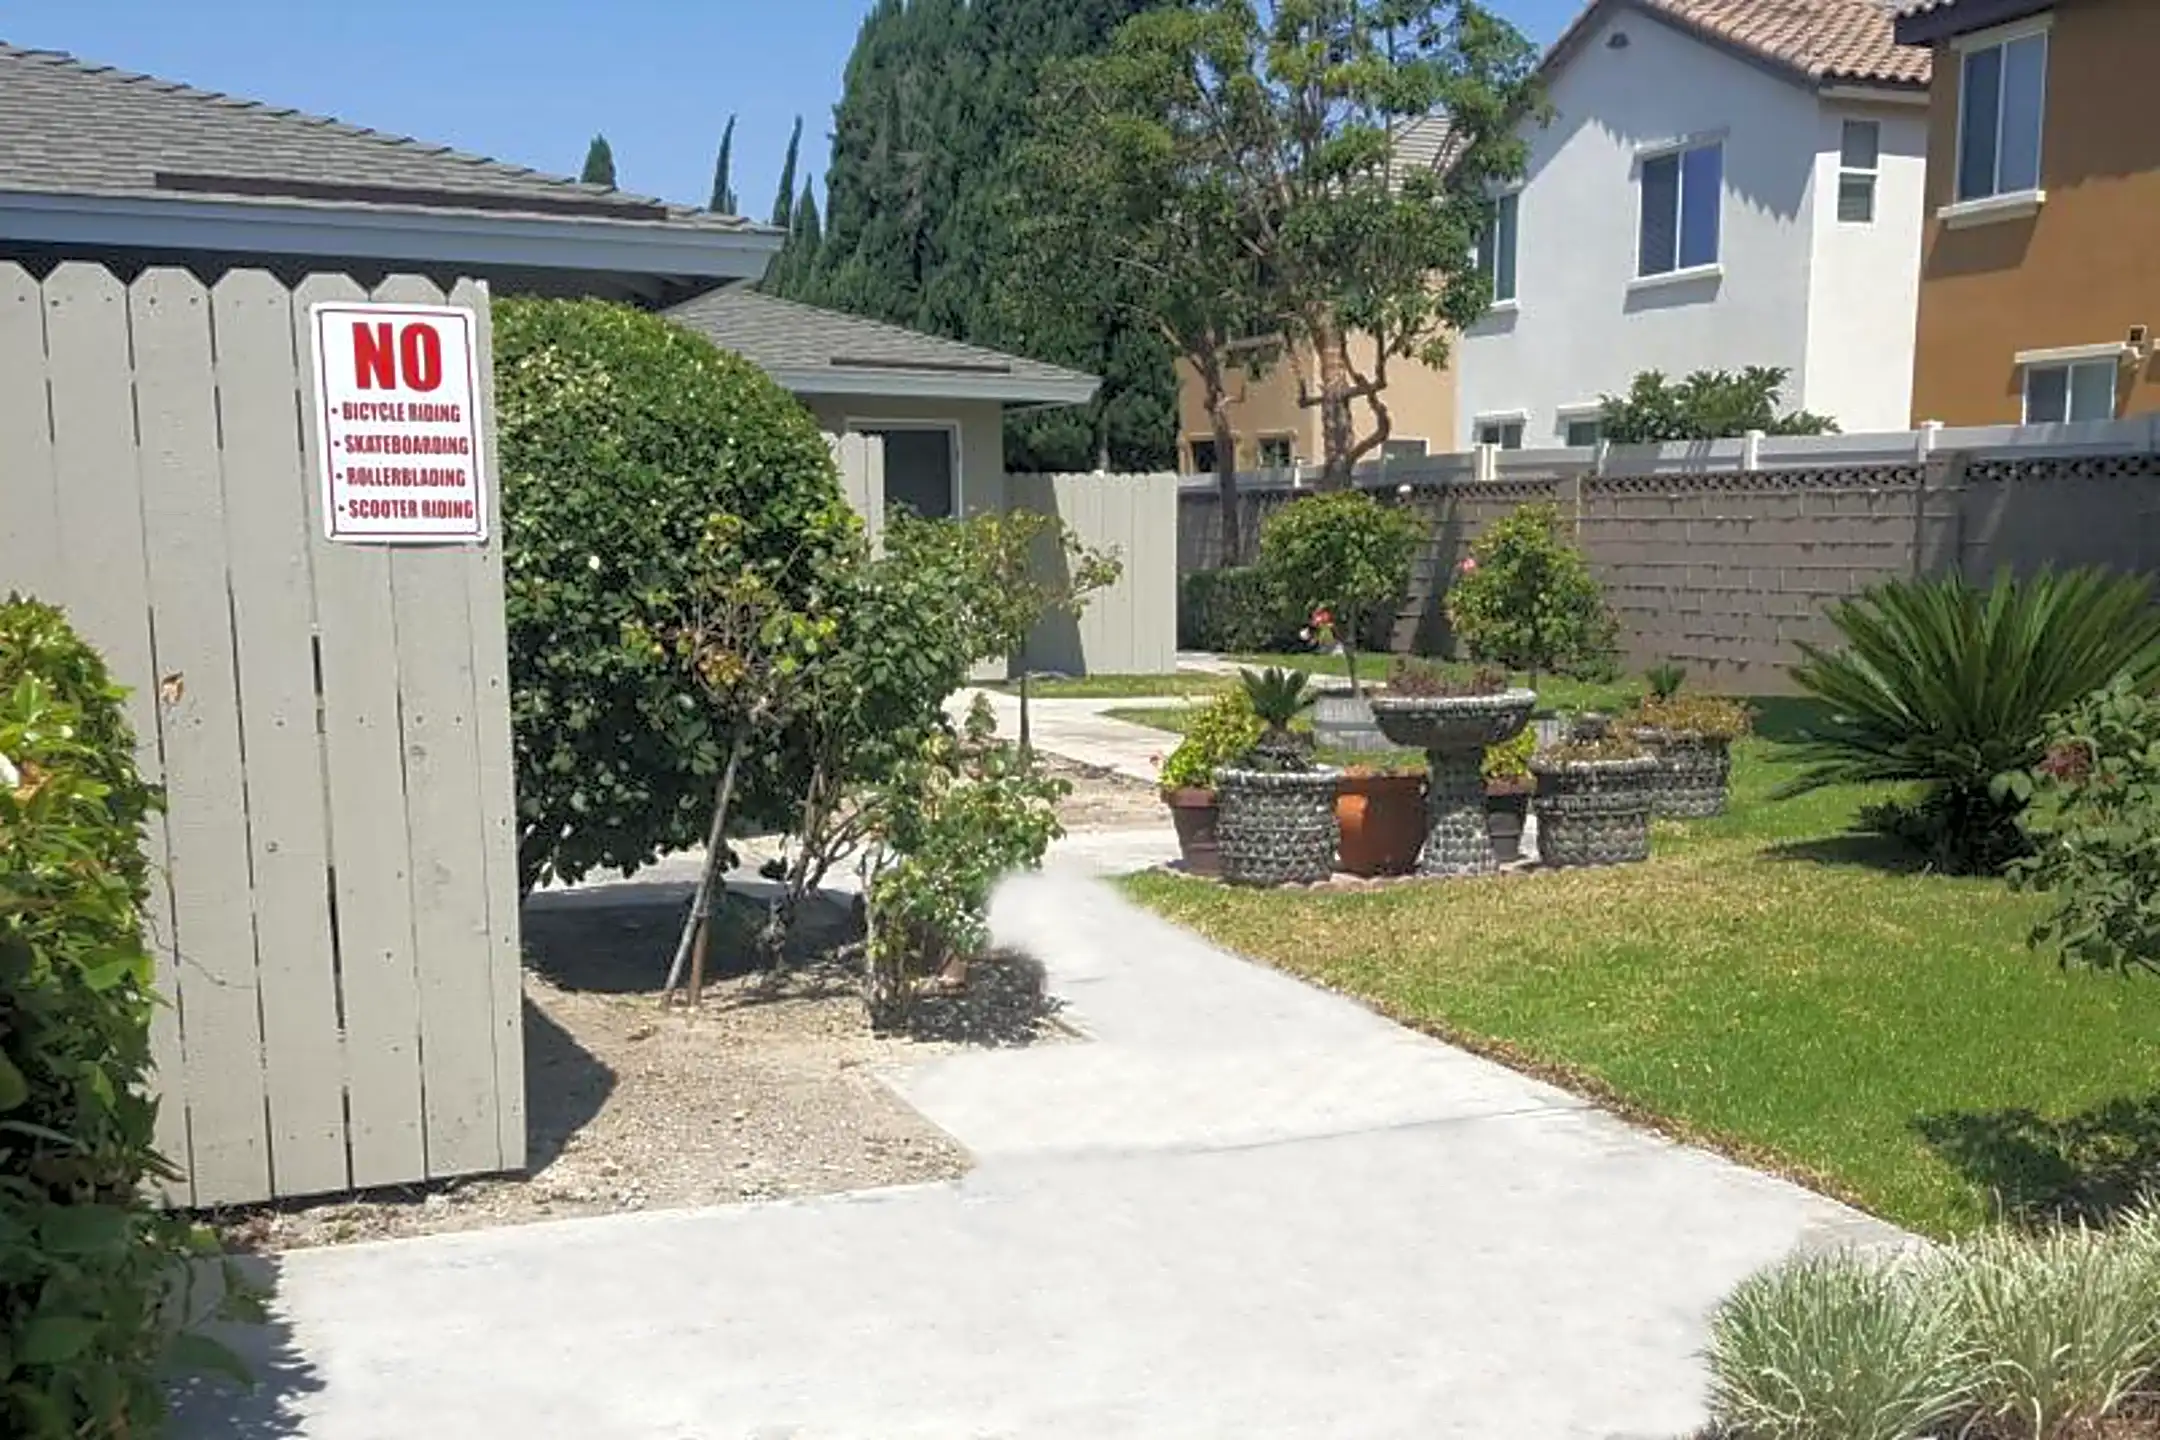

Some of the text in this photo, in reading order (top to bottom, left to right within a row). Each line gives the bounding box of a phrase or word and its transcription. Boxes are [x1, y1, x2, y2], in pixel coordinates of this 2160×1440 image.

[352, 322, 442, 392] NO
[342, 402, 461, 423] BICYCLE RIDING
[344, 435, 469, 455] SKATEBOARDING
[346, 467, 466, 487] ROLLERBLADING
[349, 499, 474, 519] SCOOTER RIDING
